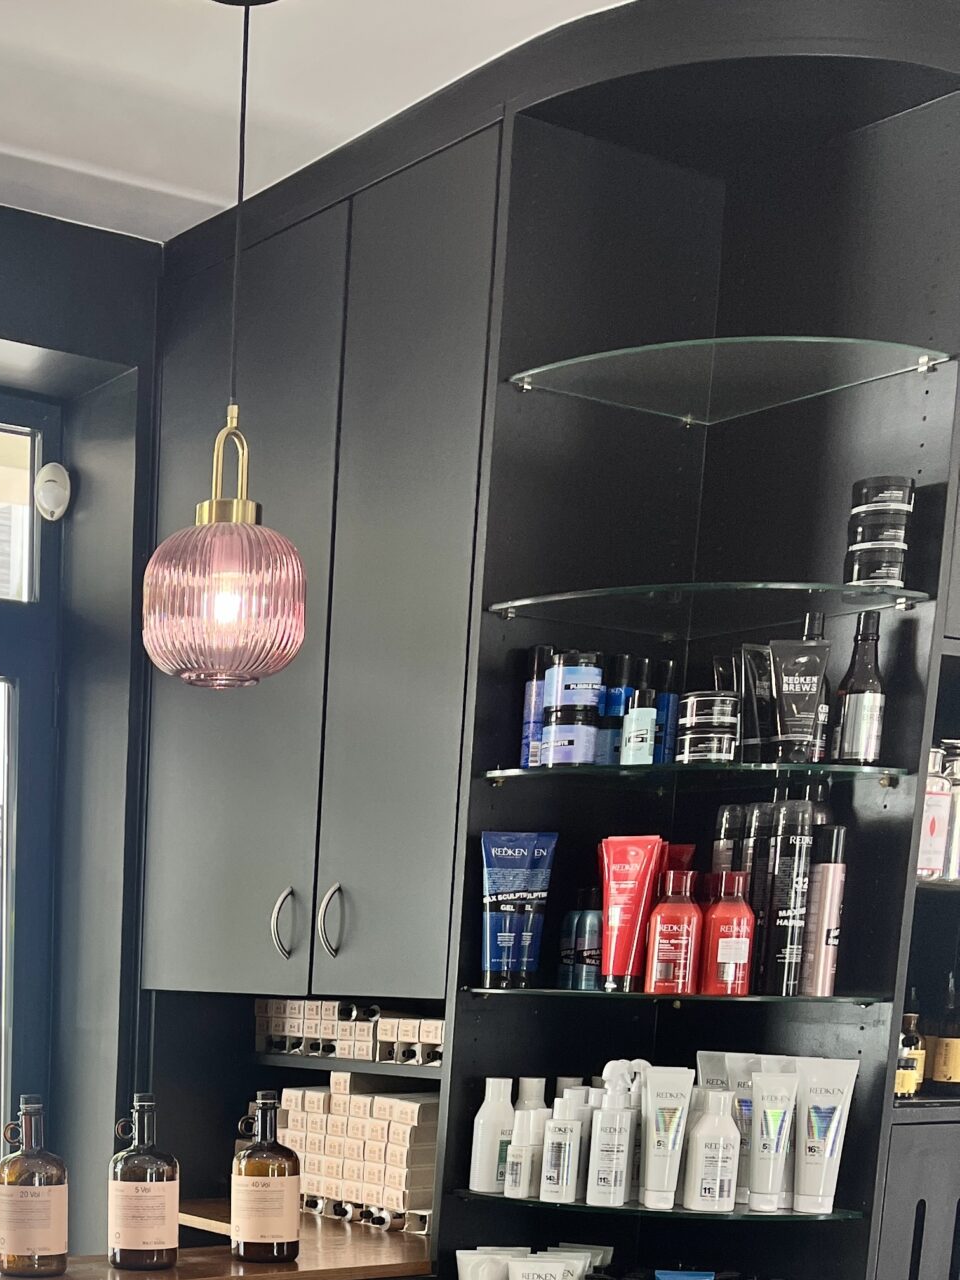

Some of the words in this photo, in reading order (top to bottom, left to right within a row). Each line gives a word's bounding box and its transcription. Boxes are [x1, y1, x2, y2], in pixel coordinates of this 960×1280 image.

[783, 675, 818, 684] REDKEN
[782, 684, 817, 692] BREWS
[492, 847, 528, 856] REDKEN
[660, 924, 691, 932] REDKEN
[720, 925, 750, 933] REDKEN
[809, 1087, 844, 1095] REDKEN
[522, 1273, 557, 1280] REDKEN
